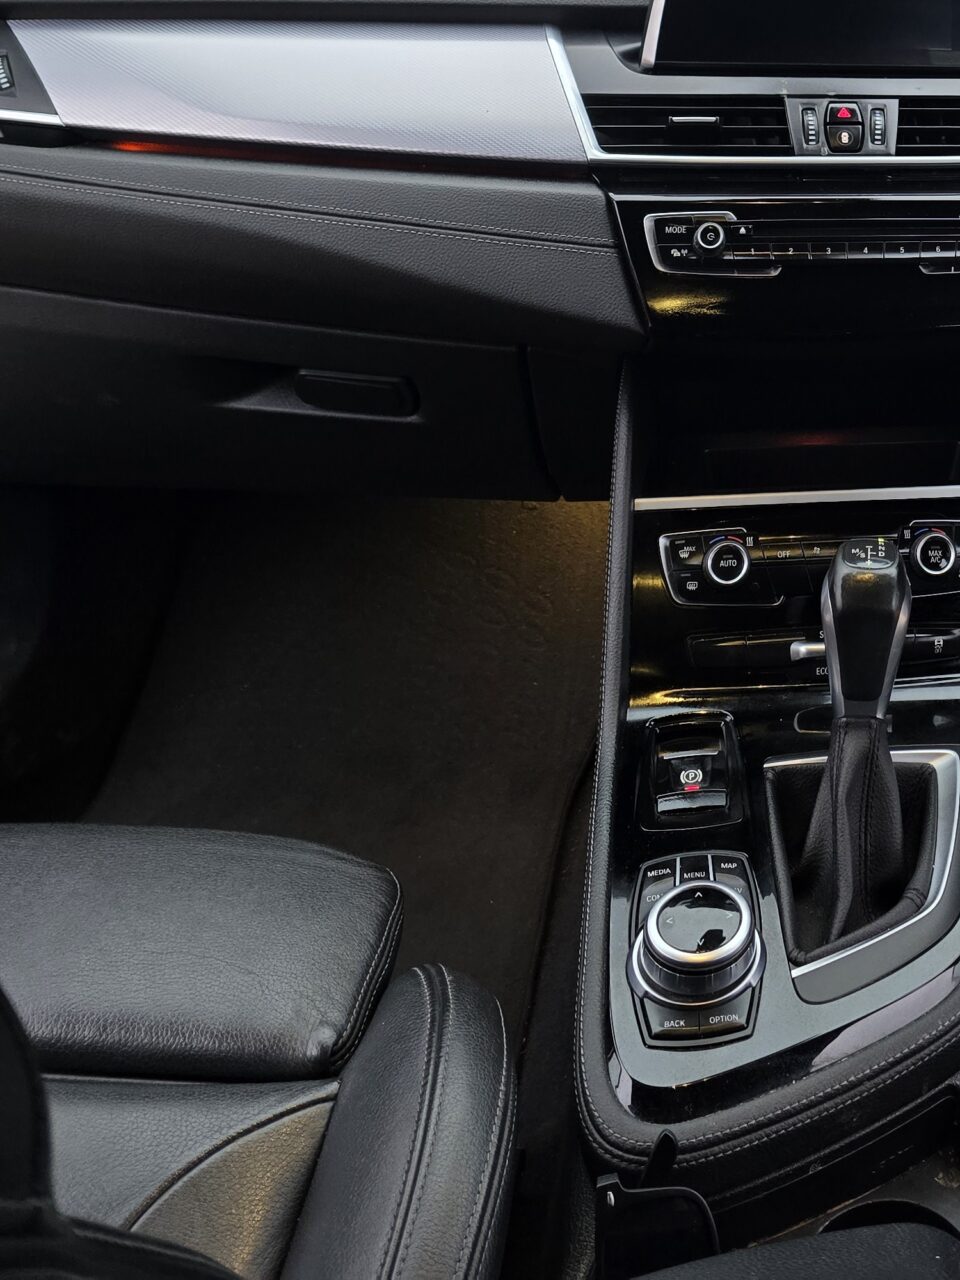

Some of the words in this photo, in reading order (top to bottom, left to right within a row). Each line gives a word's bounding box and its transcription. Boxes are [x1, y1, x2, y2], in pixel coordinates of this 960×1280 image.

[665, 226, 687, 234] MODE
[647, 868, 672, 877] MEDIA
[683, 871, 706, 879] MENU
[709, 1014, 739, 1024] OPTION
[664, 1020, 686, 1028] BACK
